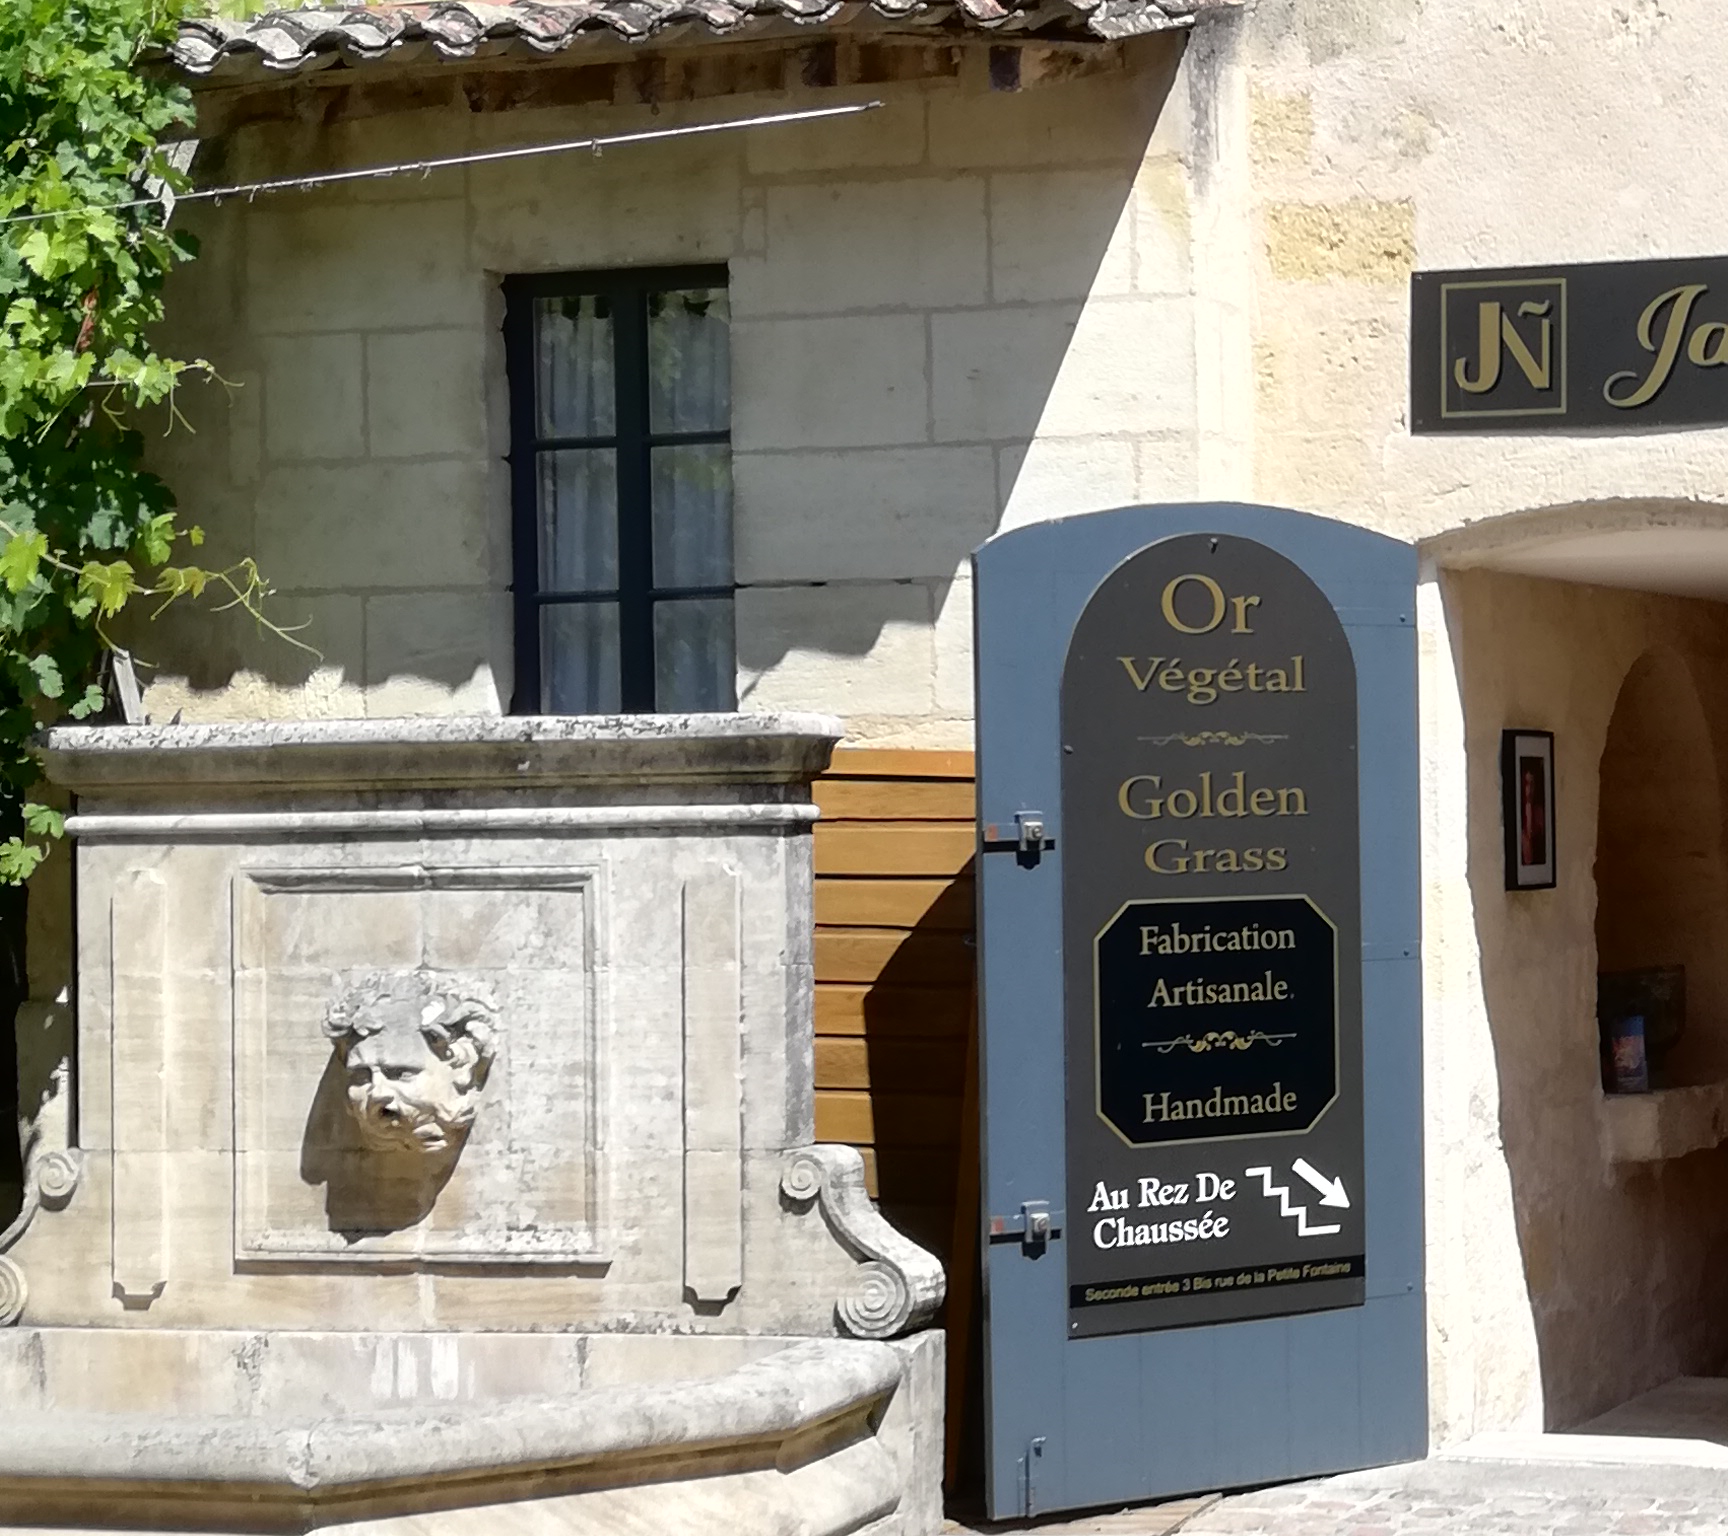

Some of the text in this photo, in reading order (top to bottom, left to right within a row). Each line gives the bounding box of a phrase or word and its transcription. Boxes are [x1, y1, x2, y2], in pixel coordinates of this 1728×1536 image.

[1160, 574, 1262, 635] Or
[1117, 655, 1307, 705] Végétal
[1117, 771, 1310, 820] Golden
[1143, 838, 1289, 875] Grass
[1139, 922, 1297, 956] Fabrication
[1142, 1082, 1298, 1124] Handmade
[1086, 1172, 1238, 1213] Au Rez De
[1093, 1209, 1231, 1250] Chaussée
[1085, 1286, 1139, 1302] Seconde
[1141, 1280, 1181, 1297] entrée
[1214, 1274, 1234, 1289] rue
[1236, 1272, 1253, 1286] de
[1253, 1269, 1266, 1284] la
[1302, 1261, 1352, 1278] Fontaine
